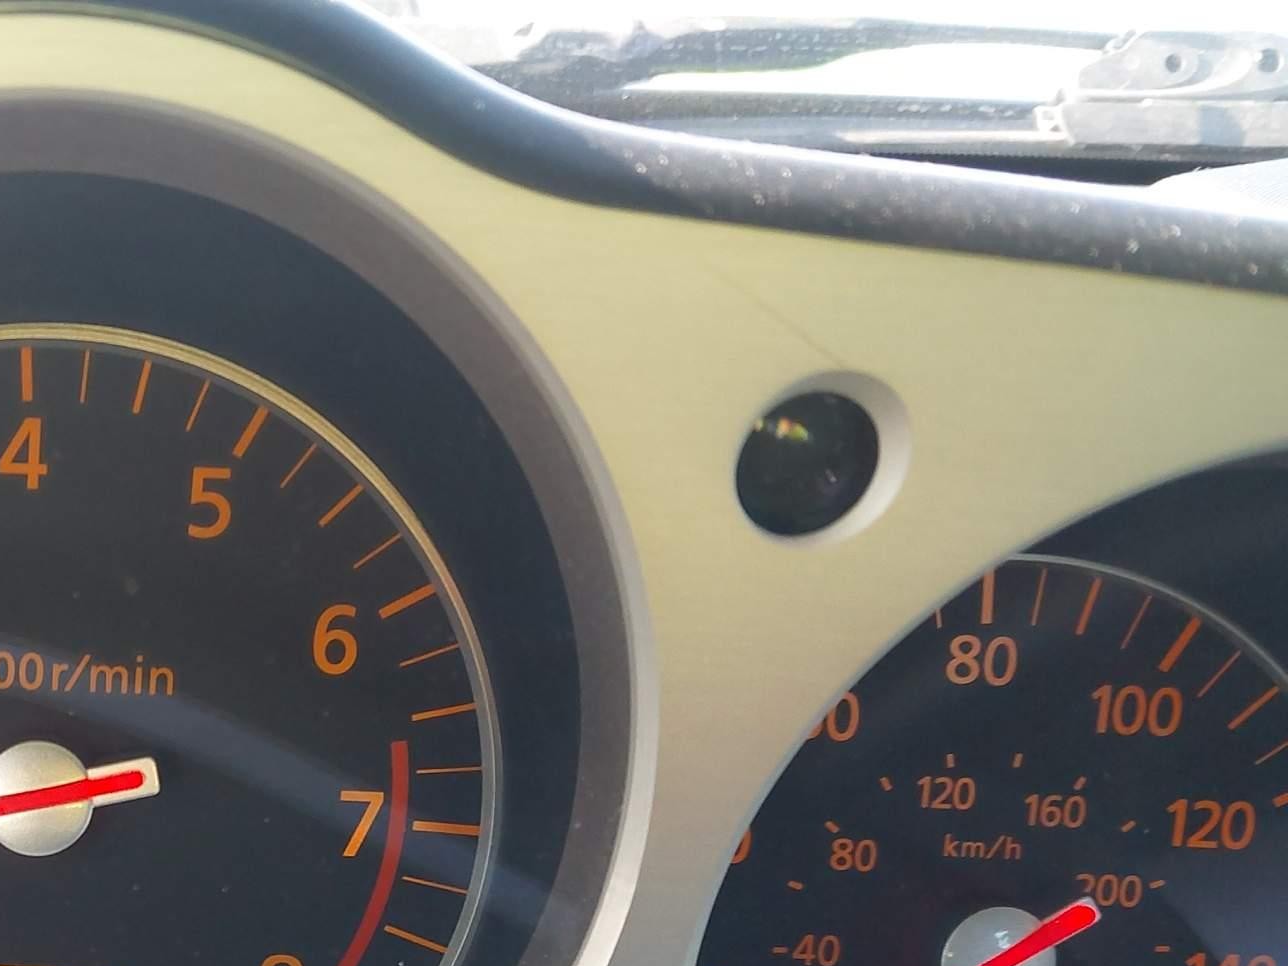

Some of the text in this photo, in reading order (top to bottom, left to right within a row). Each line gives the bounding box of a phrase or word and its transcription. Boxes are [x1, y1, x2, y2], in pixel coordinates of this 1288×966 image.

[188, 466, 231, 538] 5
[313, 604, 357, 675] 6
[945, 634, 1017, 687] 80
[808, 692, 860, 742] 0
[1090, 684, 1182, 737] 100
[917, 776, 975, 811] 120
[1024, 793, 1087, 829] 160
[340, 790, 384, 857] 7
[943, 833, 1022, 861] km/h
[1167, 798, 1256, 851] 120
[830, 838, 877, 872] 80
[1075, 873, 1143, 908] 200
